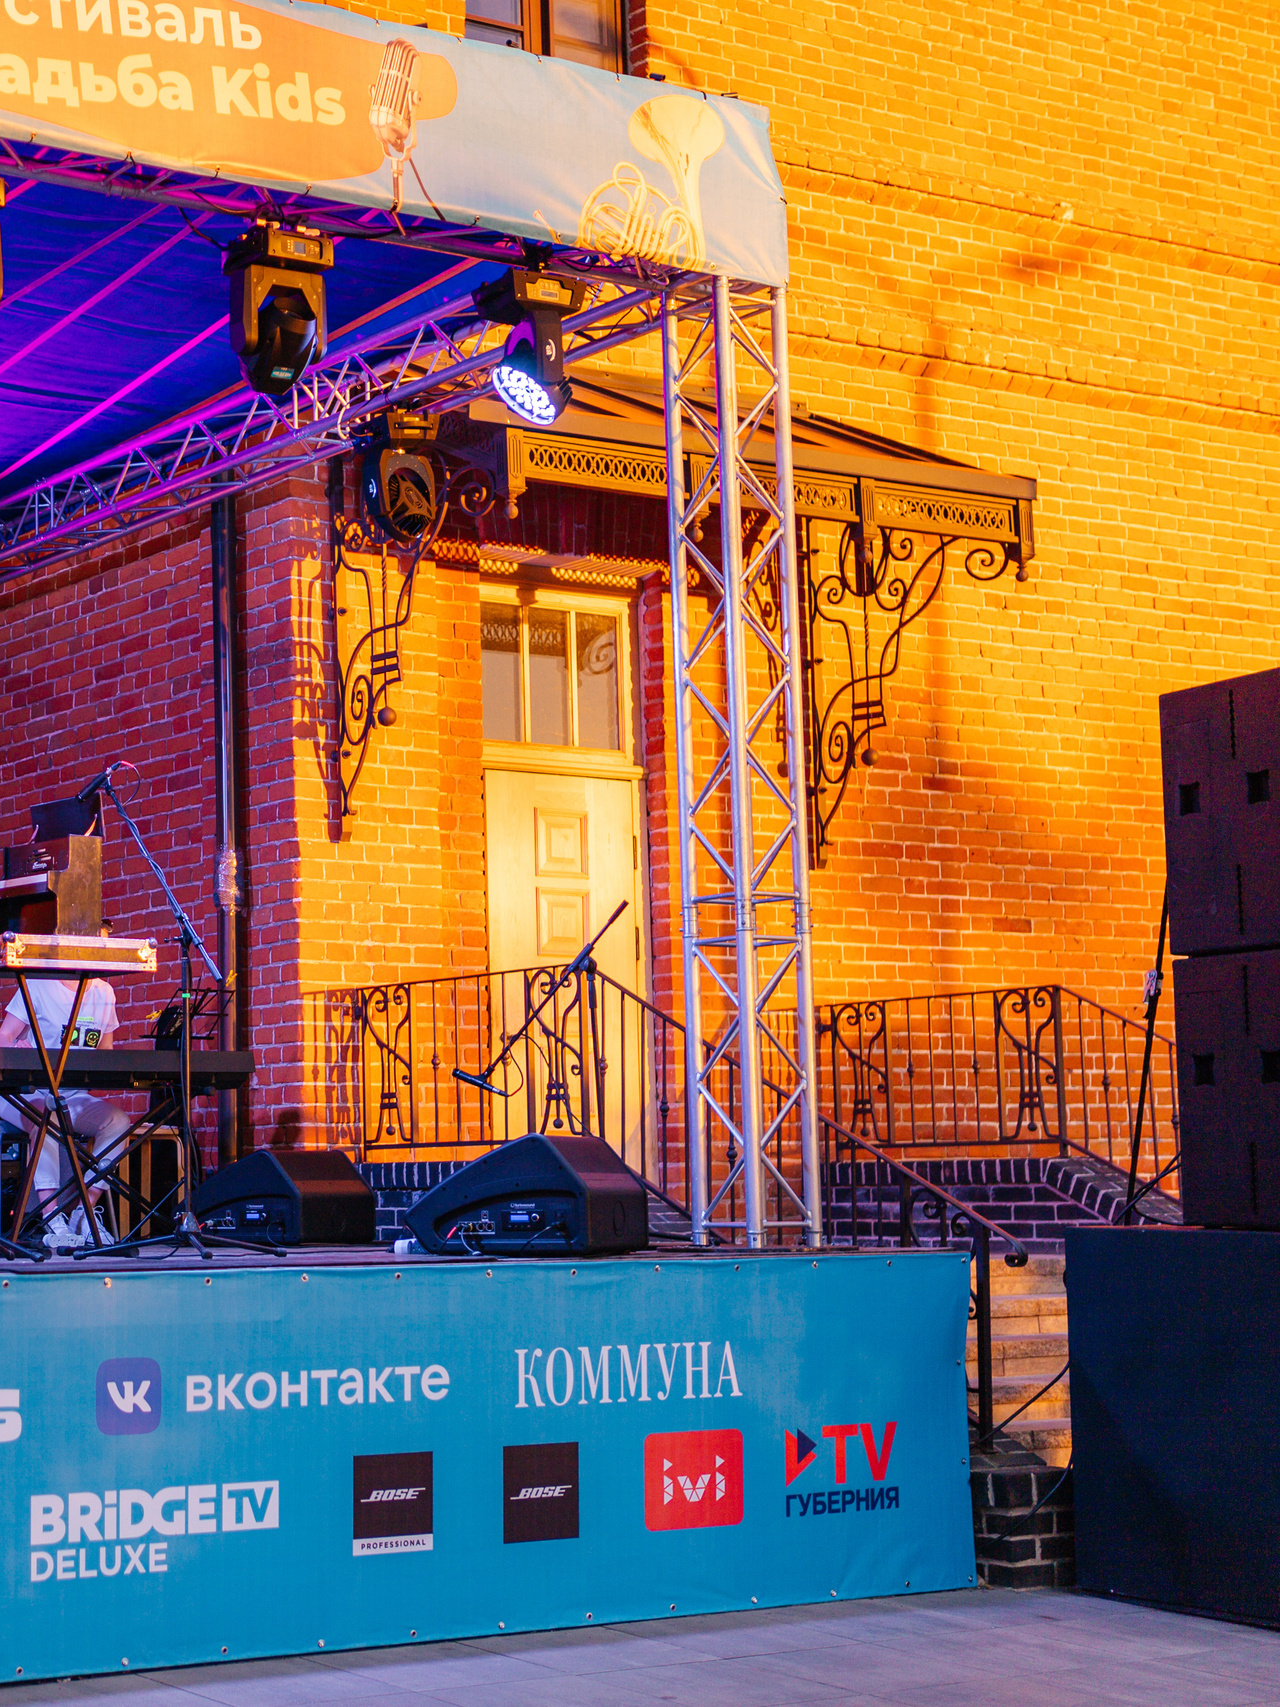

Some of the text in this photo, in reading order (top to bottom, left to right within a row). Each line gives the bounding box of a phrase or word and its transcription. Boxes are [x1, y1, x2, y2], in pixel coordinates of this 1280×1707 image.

[211, 62, 346, 126] Kids
[515, 1341, 743, 1408] КОММУНА
[822, 1421, 897, 1484] TV
[226, 1486, 275, 1525] TV
[360, 1487, 426, 1503] BOSE
[509, 1484, 572, 1501] BOSE
[785, 1486, 900, 1518] ГУБЕРНИЯ
[30, 1542, 168, 1582] DELUXE
[360, 1538, 426, 1551] PROFESSIONAL
